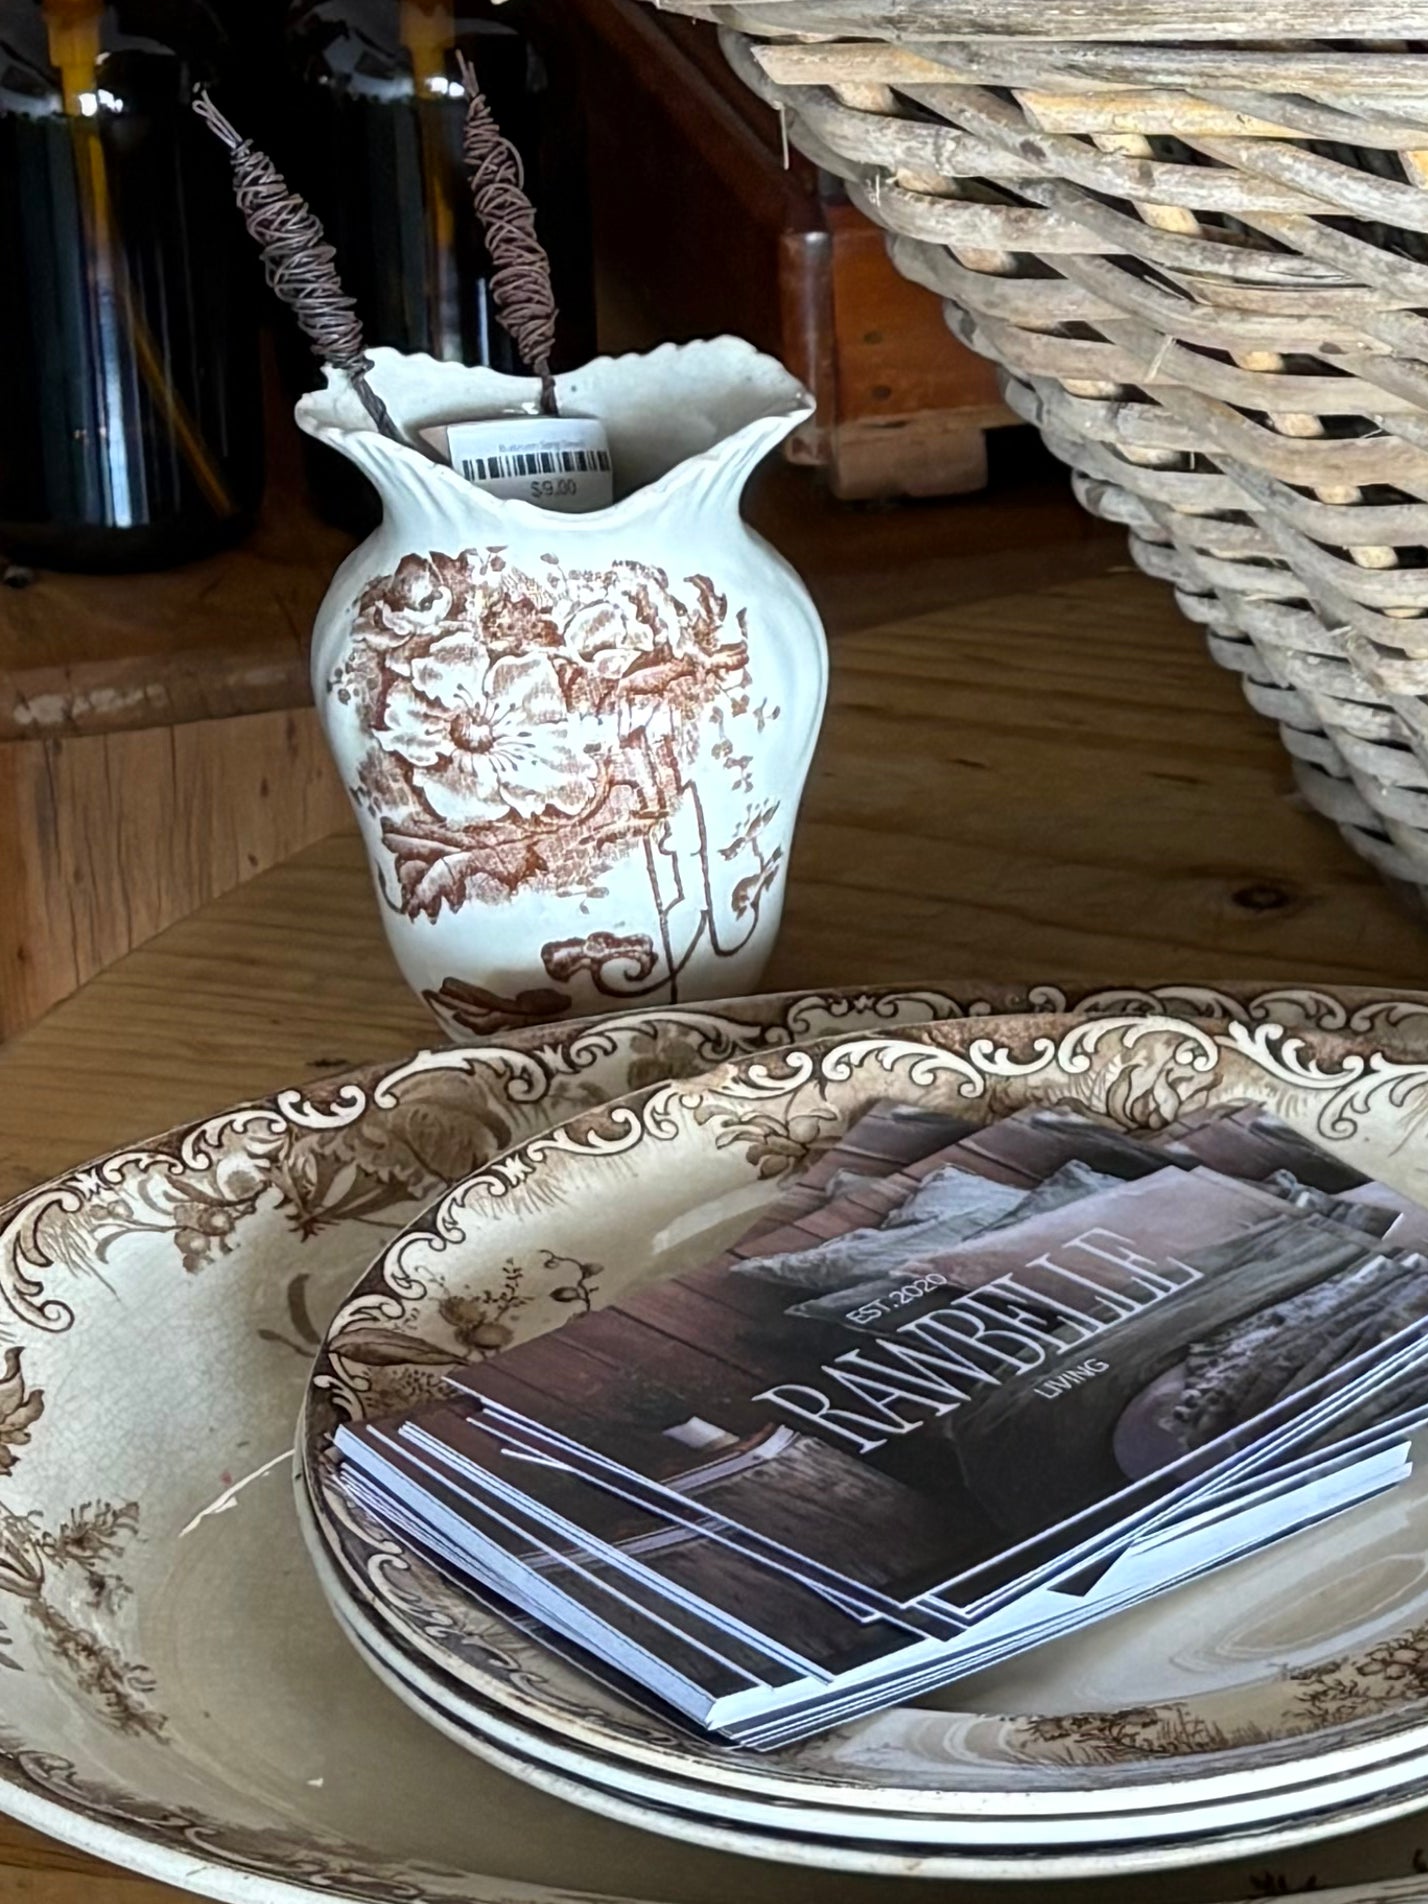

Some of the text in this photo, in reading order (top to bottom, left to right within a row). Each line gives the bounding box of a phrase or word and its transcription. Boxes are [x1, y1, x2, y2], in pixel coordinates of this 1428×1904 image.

[530, 478, 578, 498] $9.00
[751, 1227, 1205, 1455] RAWBELLE
[1034, 1357, 1110, 1401] LIVING
